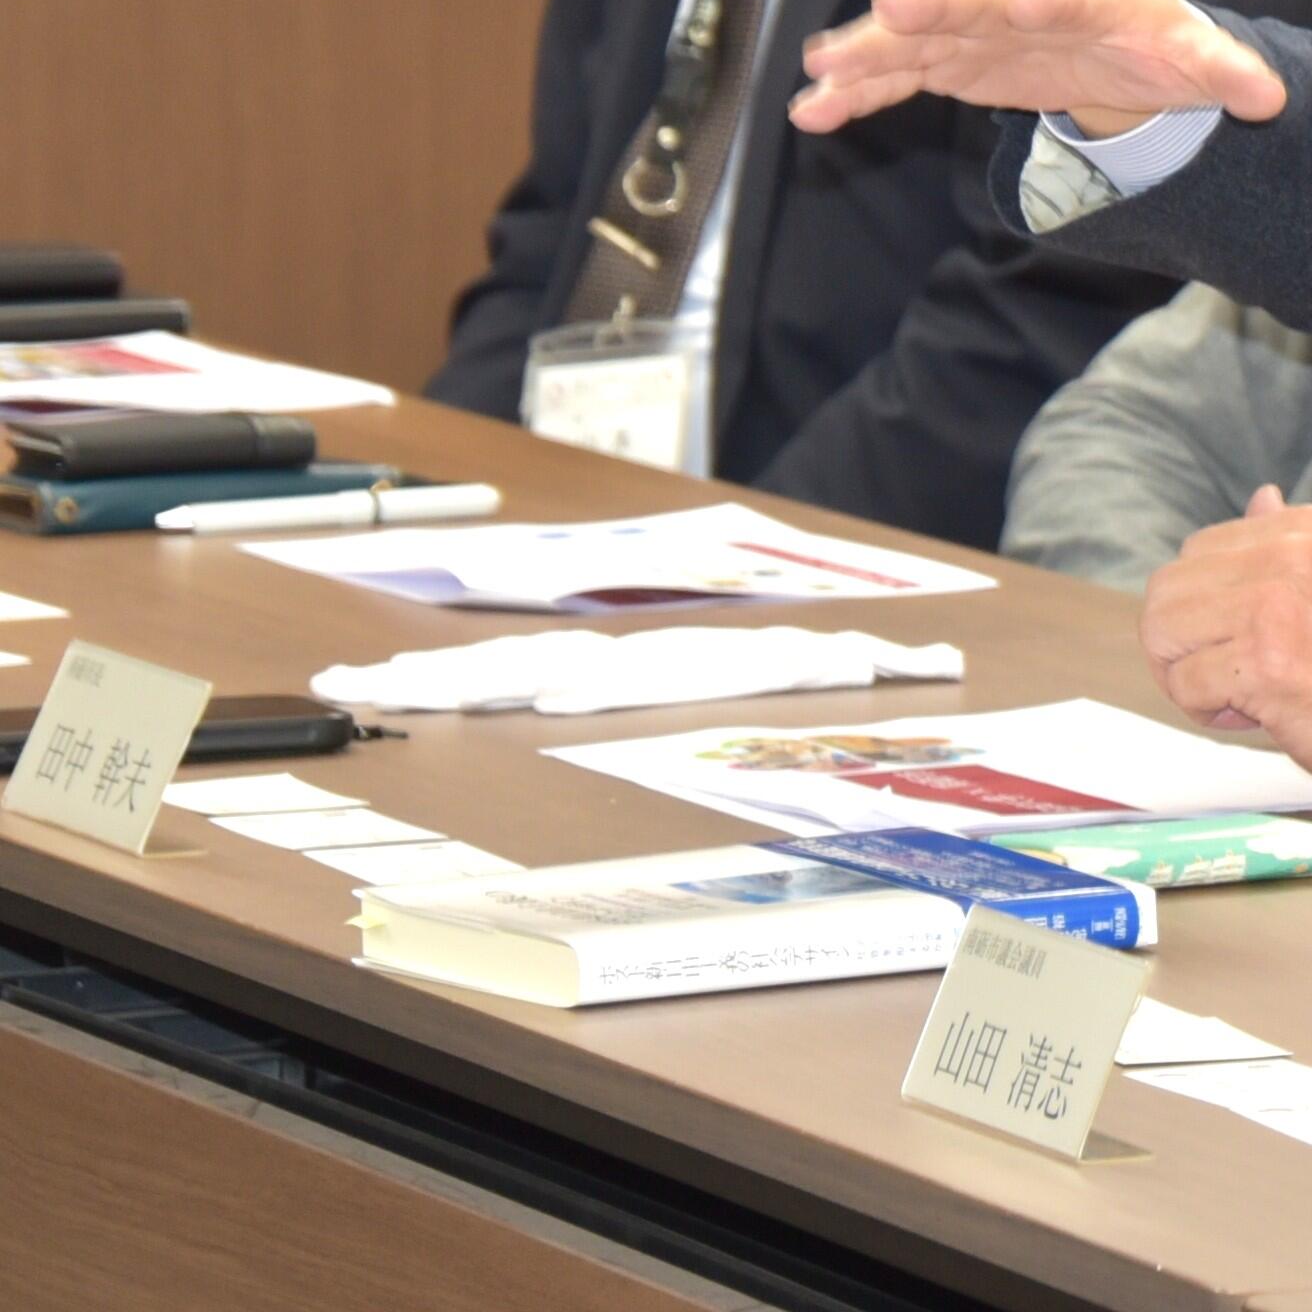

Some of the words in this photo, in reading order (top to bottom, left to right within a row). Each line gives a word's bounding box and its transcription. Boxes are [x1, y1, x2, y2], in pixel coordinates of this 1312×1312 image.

[35, 722, 94, 793] 田中
[92, 738, 152, 813] 幹夫
[934, 1011, 1008, 1094] 山田
[1006, 1032, 1083, 1120] 清志
